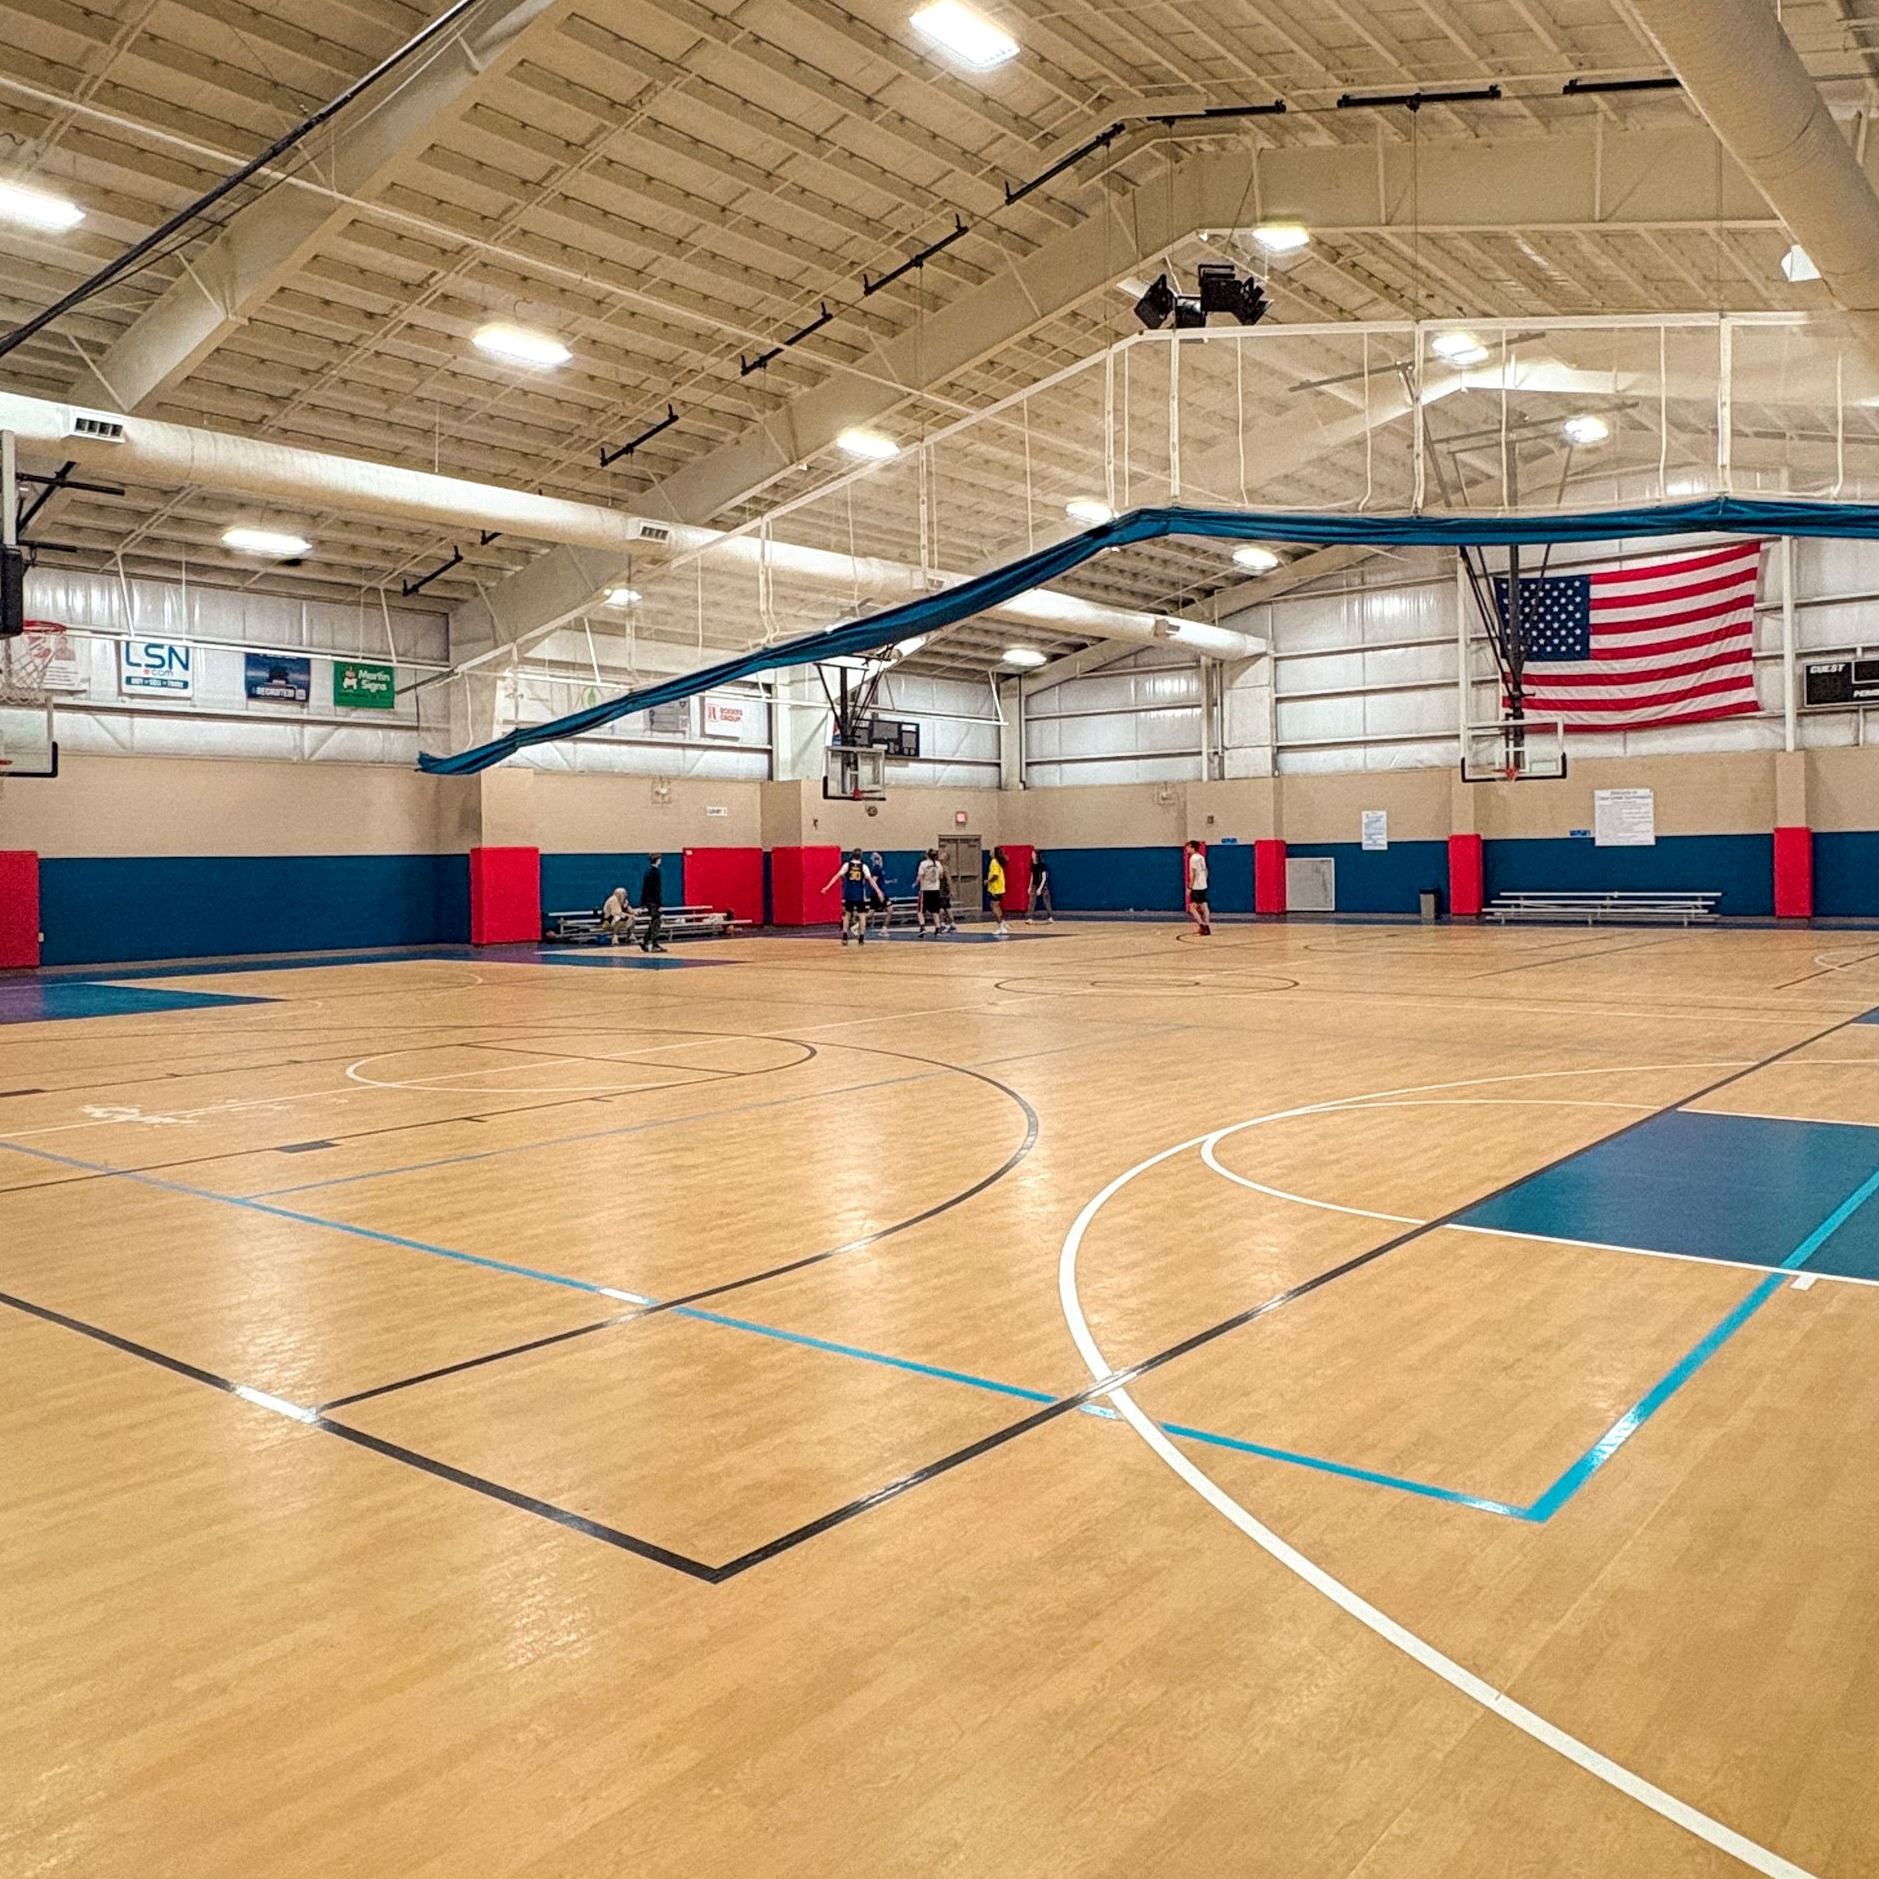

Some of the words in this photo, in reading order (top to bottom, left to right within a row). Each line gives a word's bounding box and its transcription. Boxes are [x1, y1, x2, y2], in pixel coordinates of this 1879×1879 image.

[125, 641, 189, 671] LSN
[358, 669, 391, 682] Martin
[1810, 664, 1846, 674] GUEST
[361, 679, 388, 693] Signs
